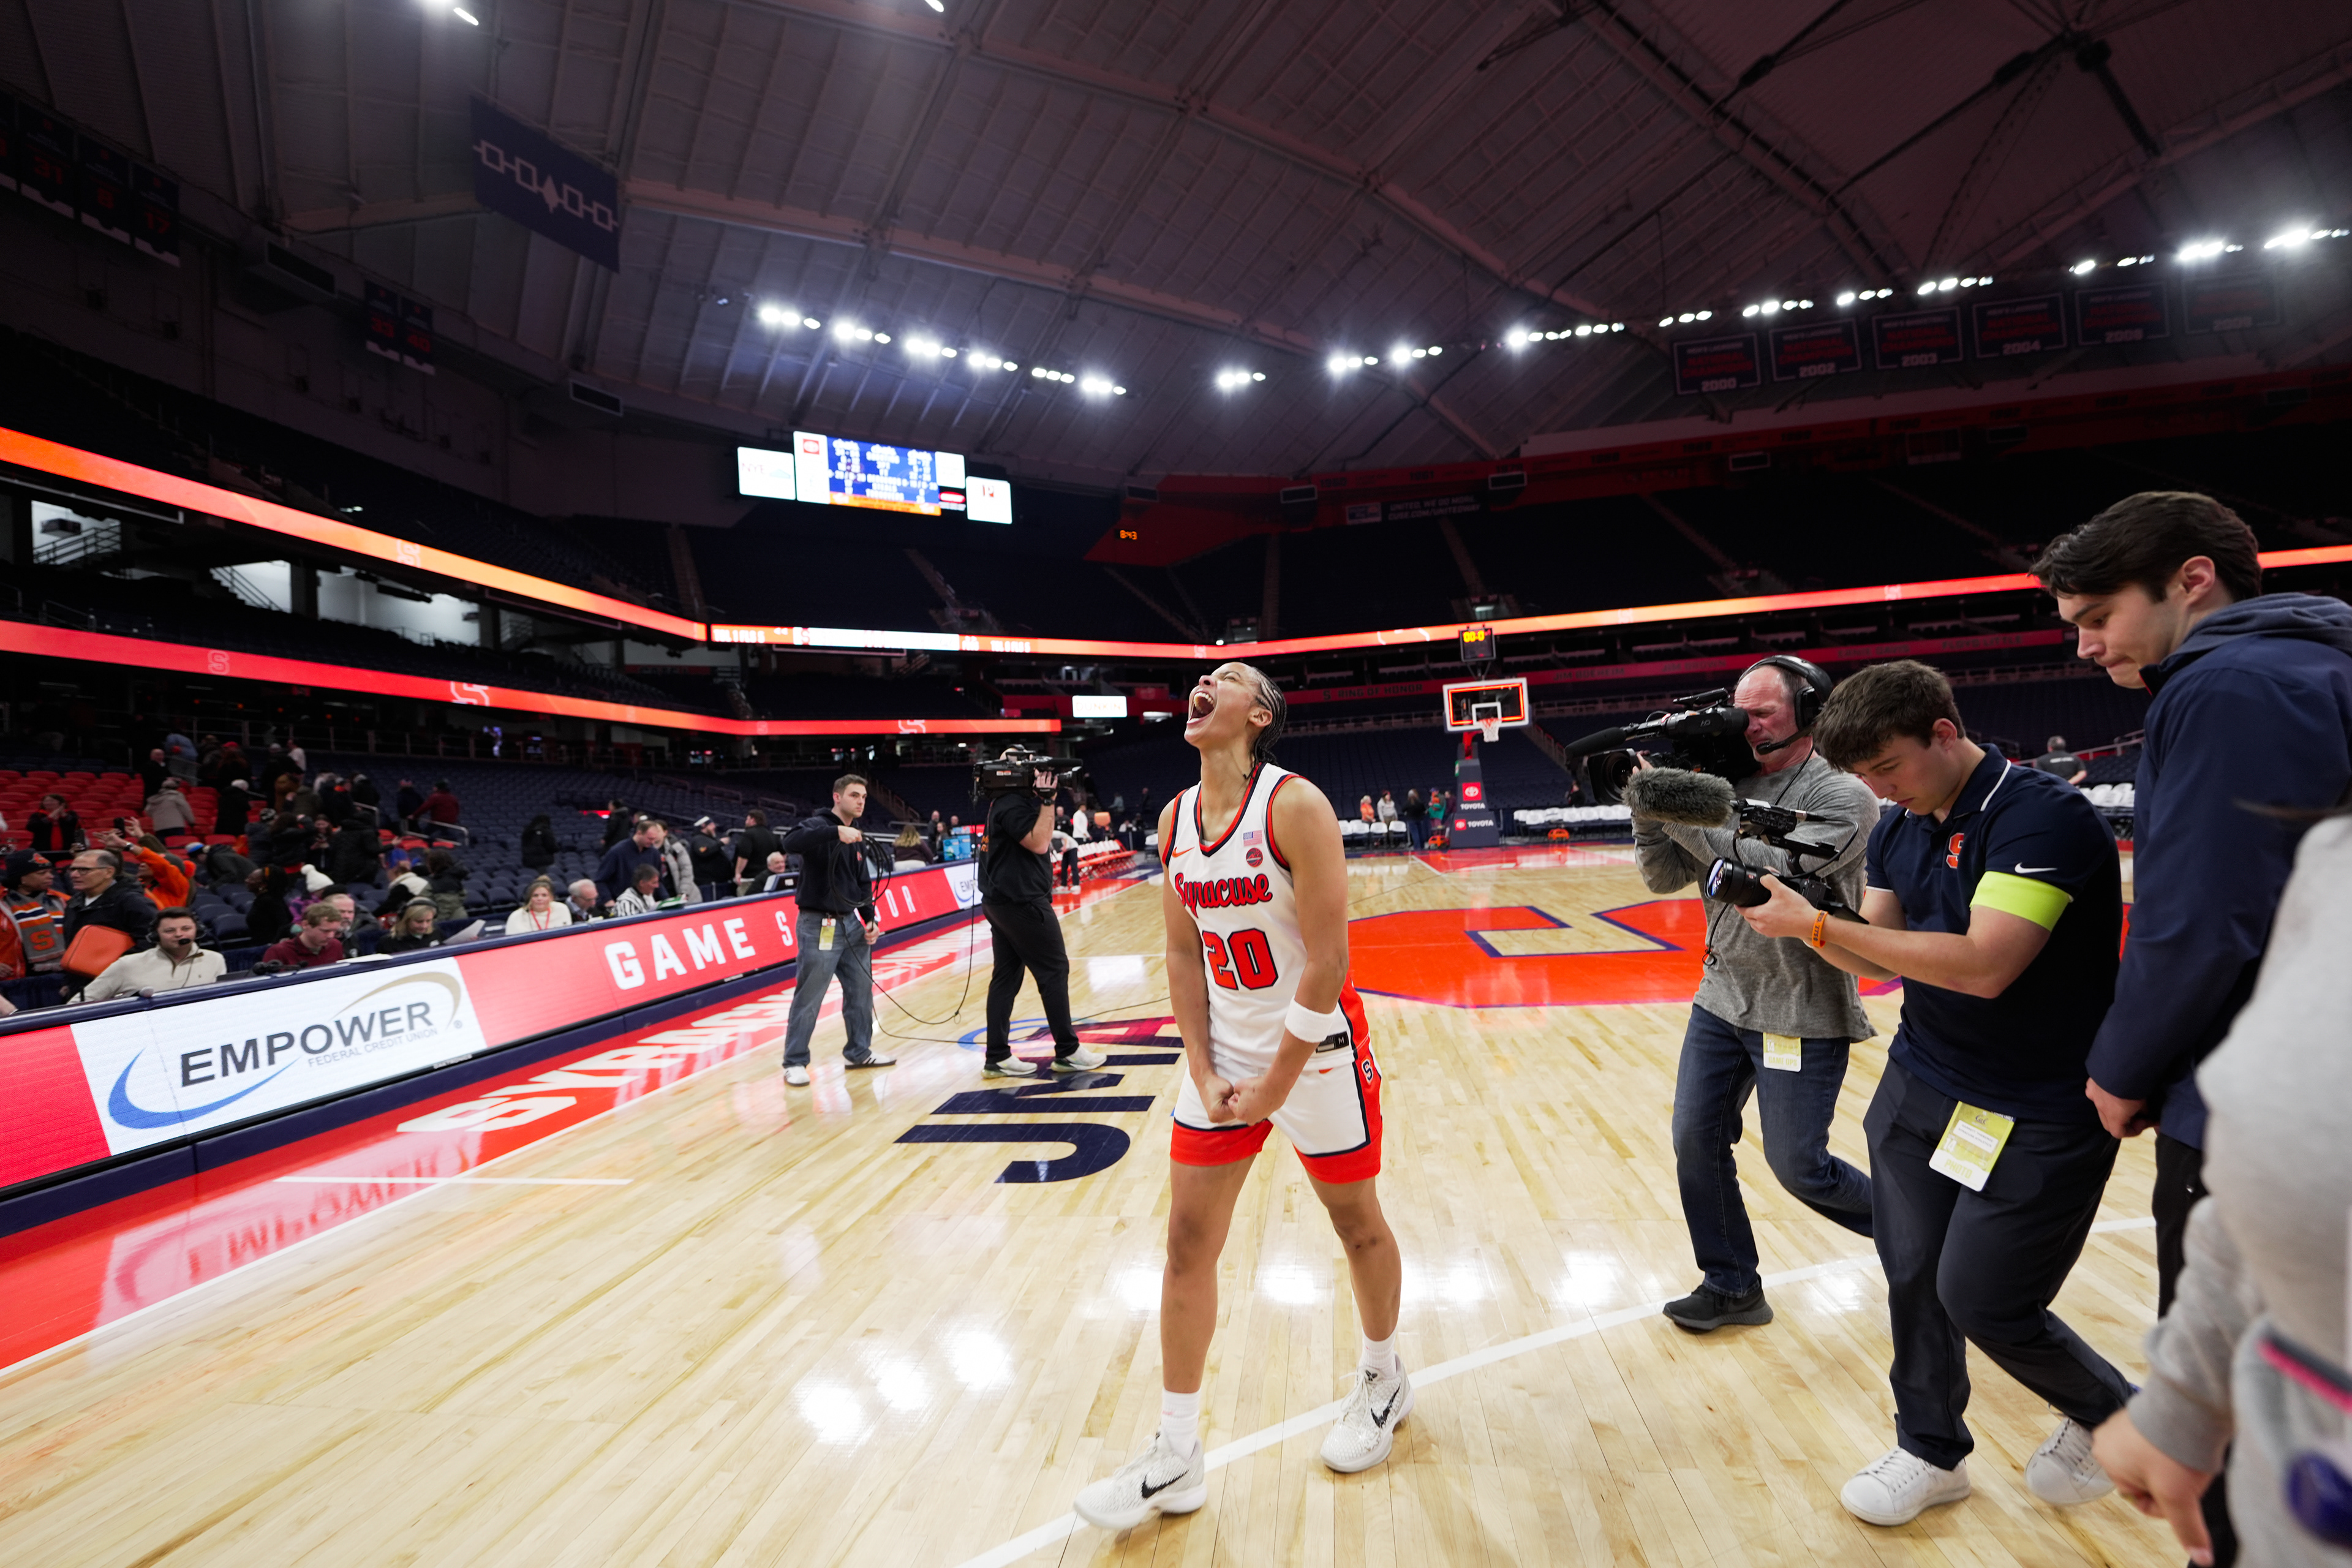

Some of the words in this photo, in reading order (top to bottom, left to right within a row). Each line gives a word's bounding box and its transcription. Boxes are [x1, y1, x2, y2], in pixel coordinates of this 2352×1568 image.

[33, 156, 63, 185] 31
[145, 211, 171, 235] 17
[2002, 339, 2041, 355] 2004
[1902, 352, 1937, 368] 2003
[1799, 362, 1836, 378] 2002
[1702, 377, 1737, 392] 2000
[1942, 639, 1980, 650] FLOYD
[1983, 635, 2022, 647] LITTLE
[1662, 663, 1681, 672] JIM
[1684, 660, 1727, 670] BROWN
[1553, 671, 1572, 681] JIM
[1575, 668, 1625, 679] BOEHEIM
[1338, 688, 1364, 698] RING
[1366, 687, 1380, 696] OF
[1384, 684, 1423, 694] HONOR
[1174, 872, 1273, 918] Syracuse
[32, 929, 55, 950] S
[605, 918, 756, 990] GAME
[1202, 927, 1279, 990] 20
[181, 1001, 434, 1087] EMPOWER
[307, 1049, 362, 1068] FEDERAL
[364, 1036, 404, 1054] CREDIT
[408, 1027, 437, 1044] UNION
[1338, 1036, 1344, 1044] M
[1767, 1041, 1774, 1052] 14
[1768, 1056, 1784, 1065] GAME
[1785, 1058, 1797, 1066] OPS
[1975, 1114, 1986, 1125] Cal
[1943, 1137, 1958, 1153] 14
[1944, 1159, 1973, 1179] PHOTO
